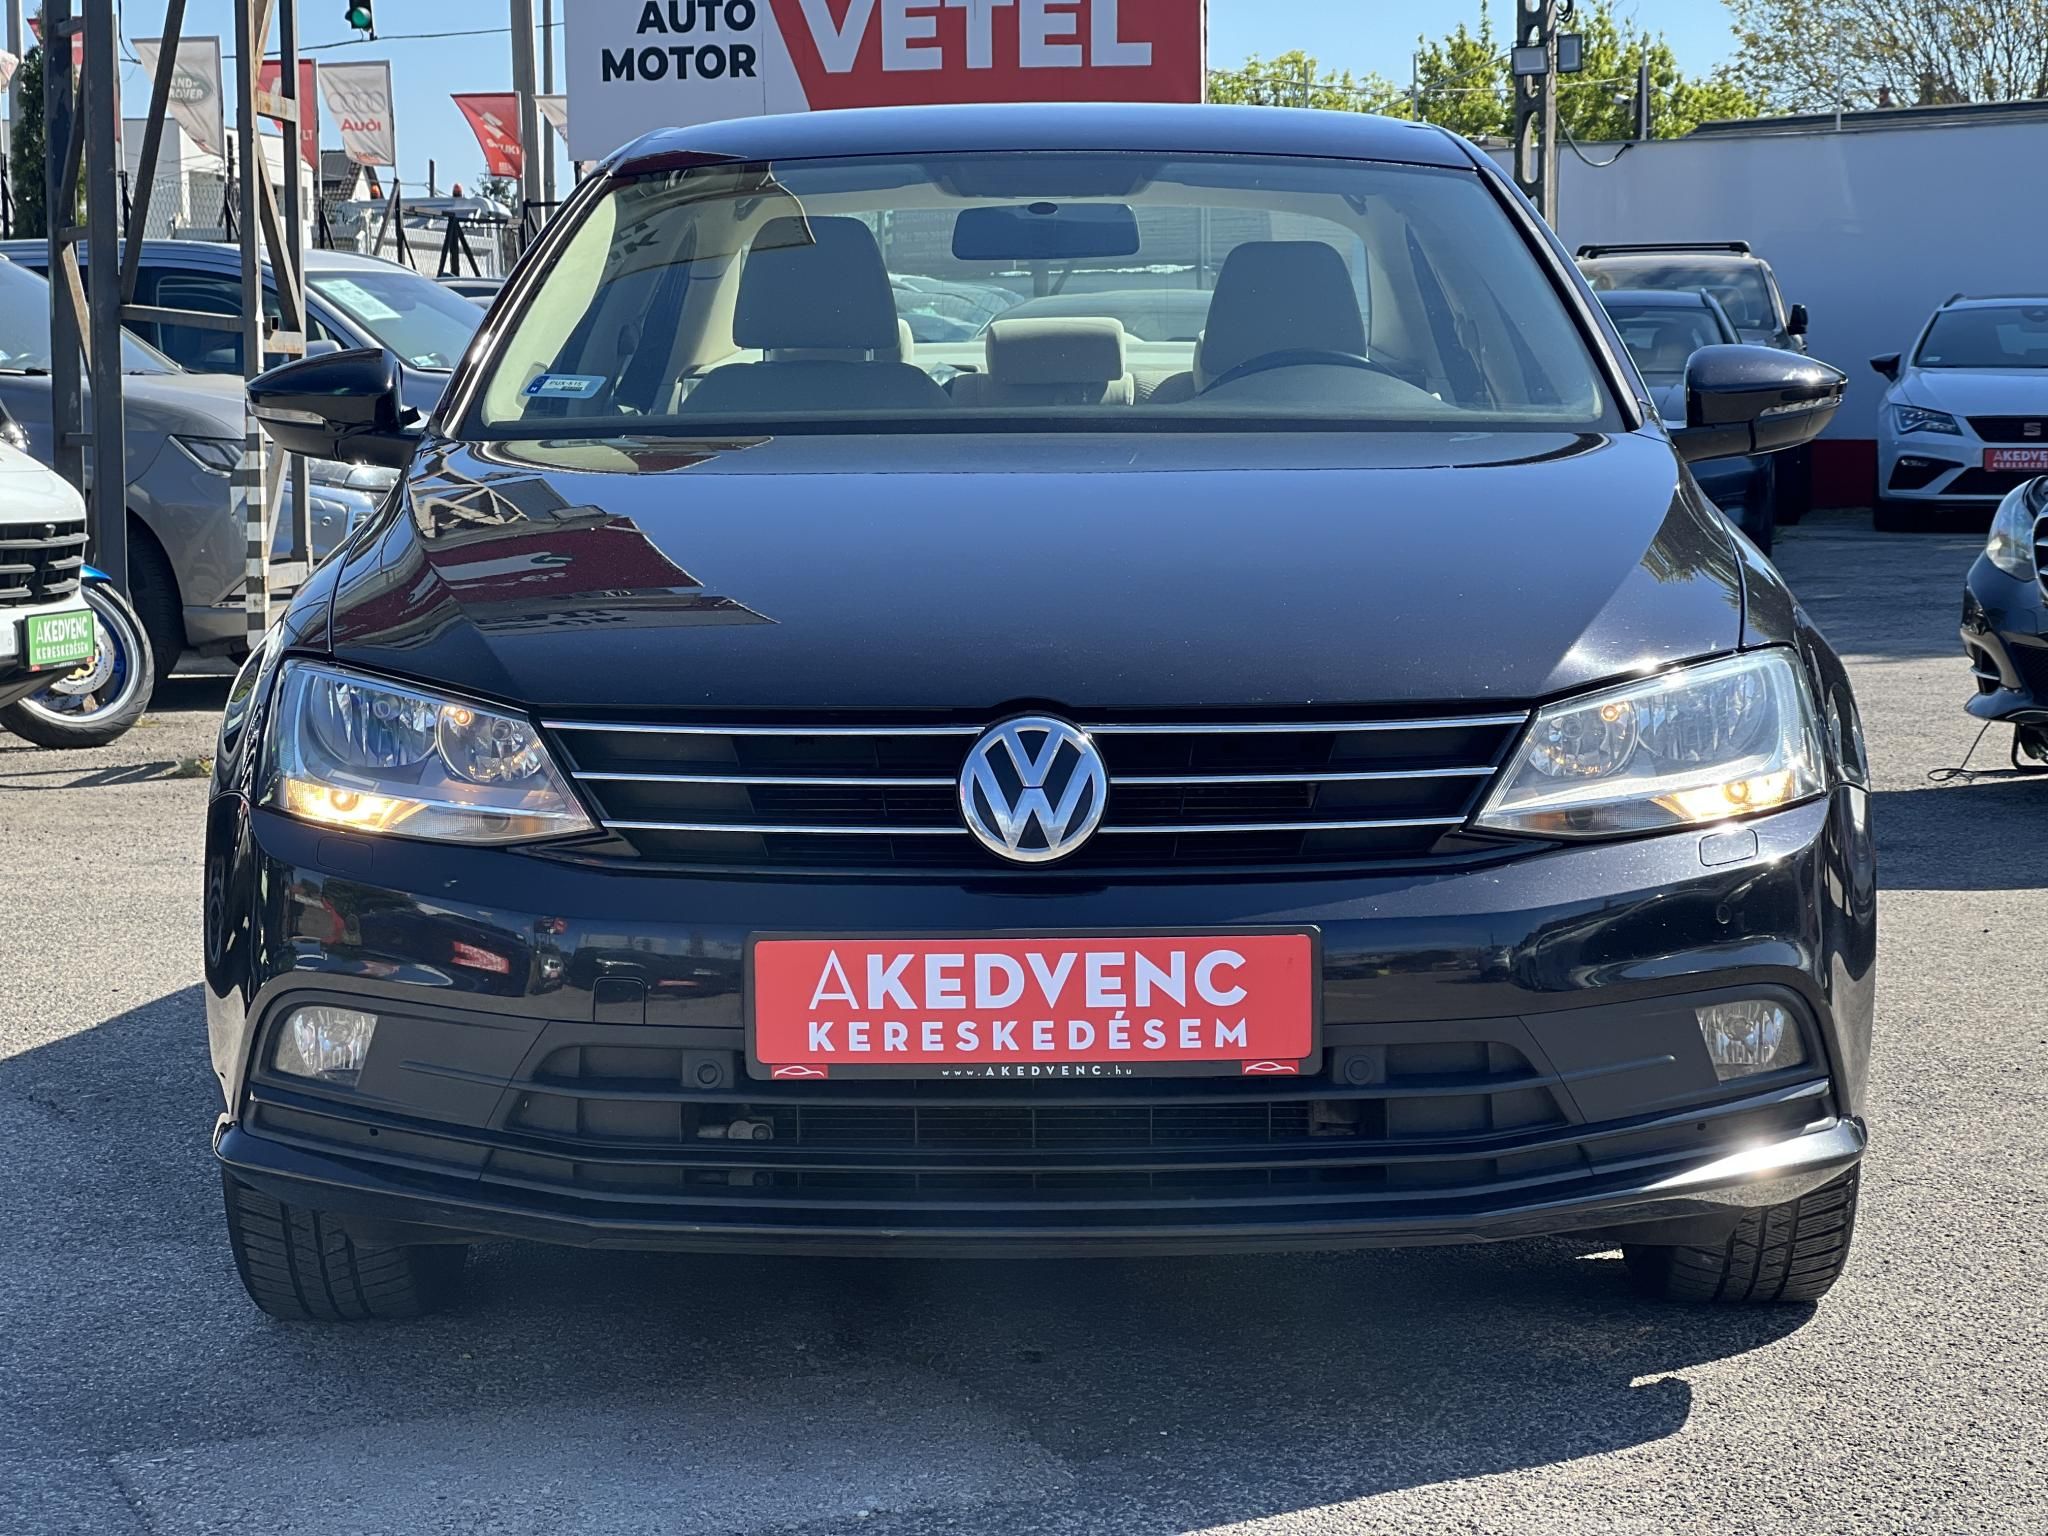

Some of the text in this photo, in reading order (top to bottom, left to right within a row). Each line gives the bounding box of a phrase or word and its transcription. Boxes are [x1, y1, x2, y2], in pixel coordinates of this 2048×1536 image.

[636, 0, 756, 34] AUTO
[601, 44, 757, 82] MOTOR
[36, 617, 87, 643] AKEDVENC
[808, 949, 1248, 1009] AKEDVENC
[808, 1010, 1248, 1051] KERESKEDÉSEM
[941, 1065, 1132, 1077] www.AKEDVENC.hu
